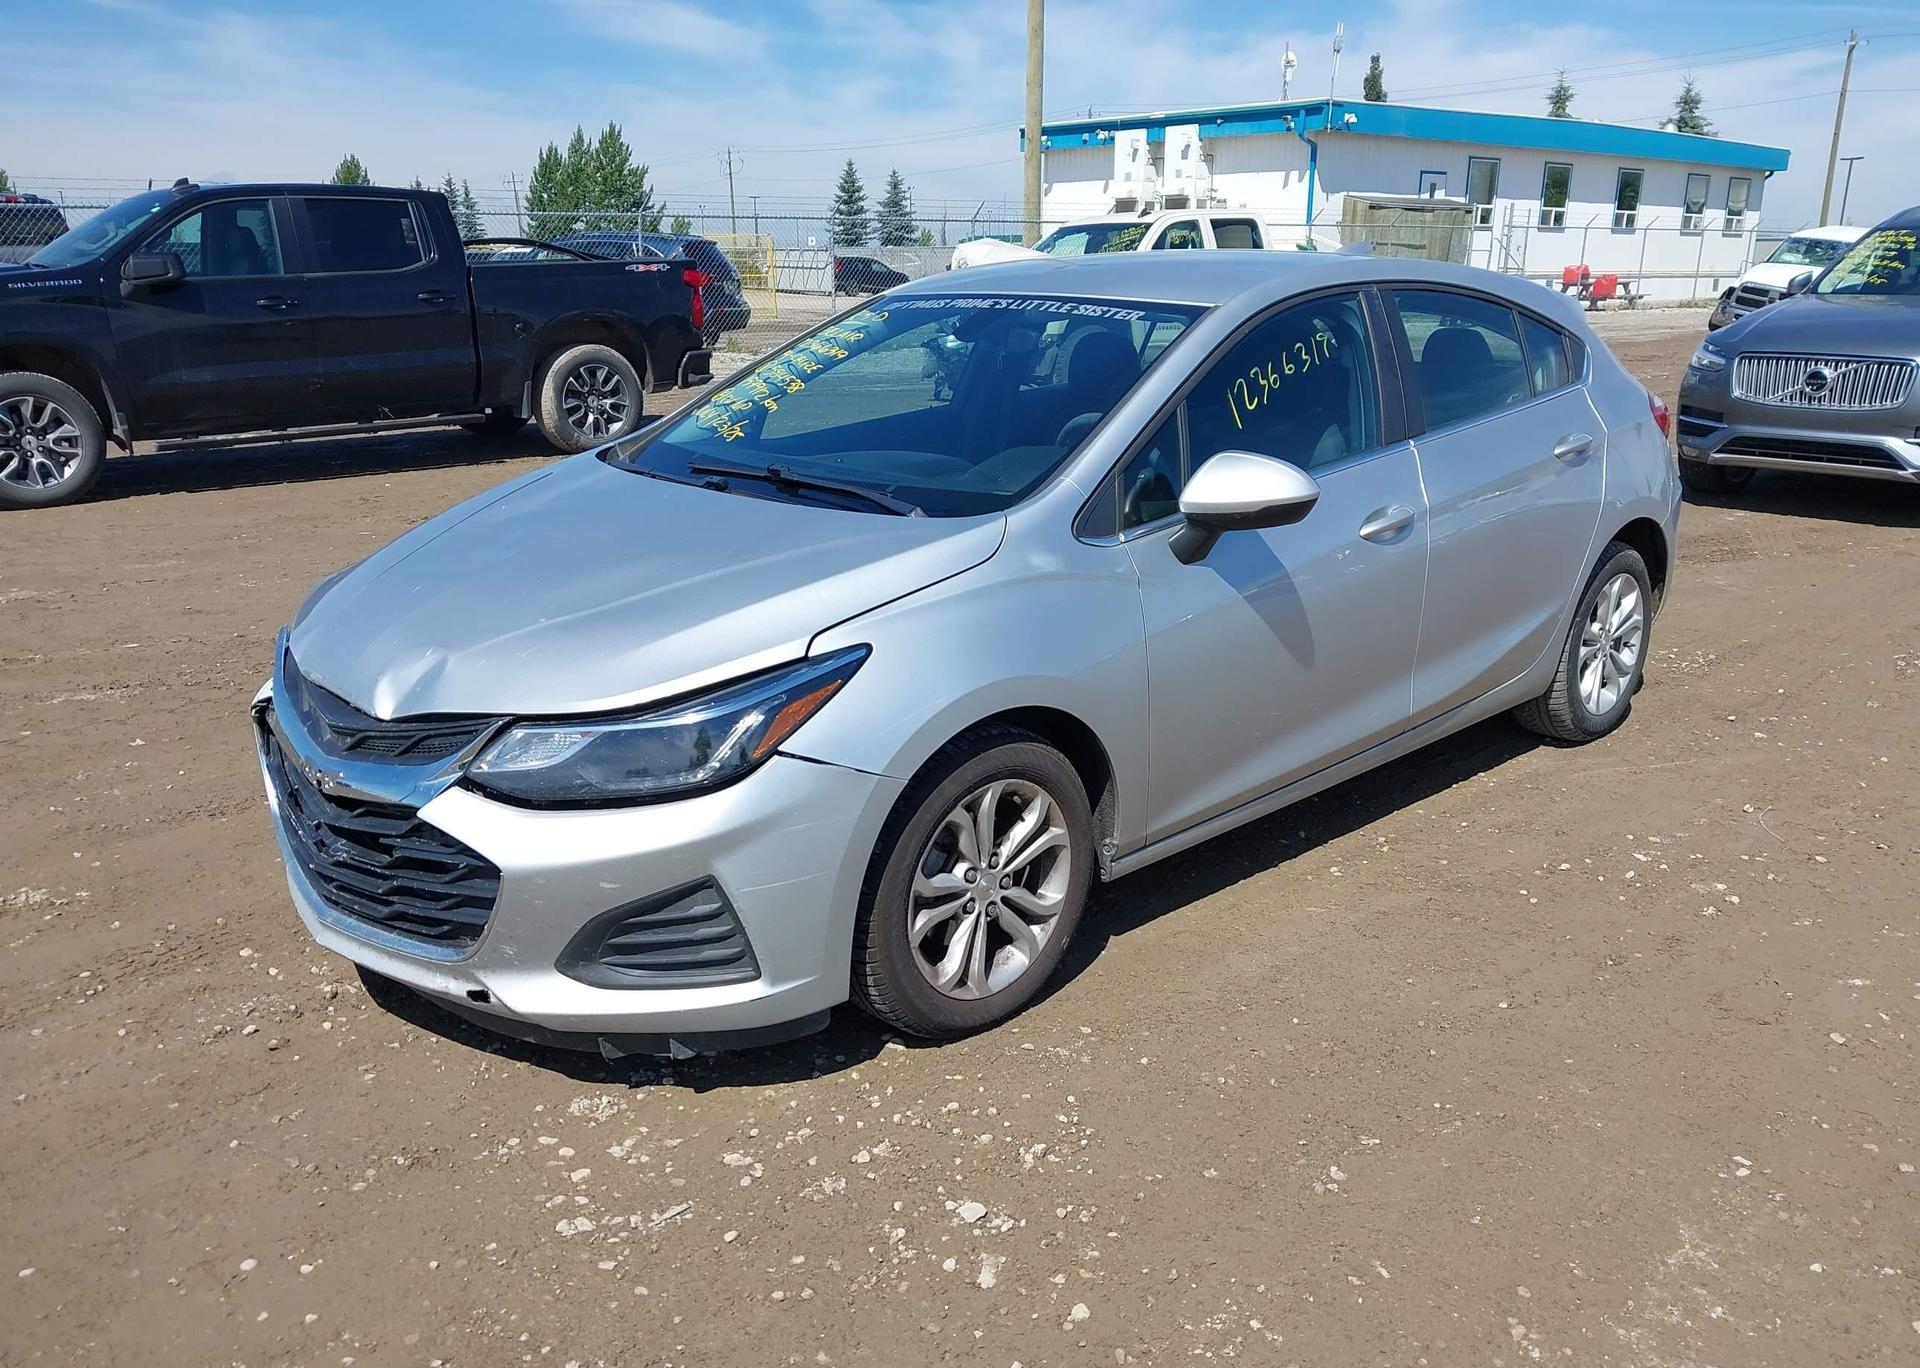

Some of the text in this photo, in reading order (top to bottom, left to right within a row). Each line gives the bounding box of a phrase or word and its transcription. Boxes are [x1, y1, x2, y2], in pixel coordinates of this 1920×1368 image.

[8, 279, 82, 289] SILVERADO
[886, 299, 951, 310] OPTIMUS
[1008, 299, 1078, 313] LITTLE
[1072, 304, 1146, 320] SISTER
[1226, 331, 1331, 430] 12366319
